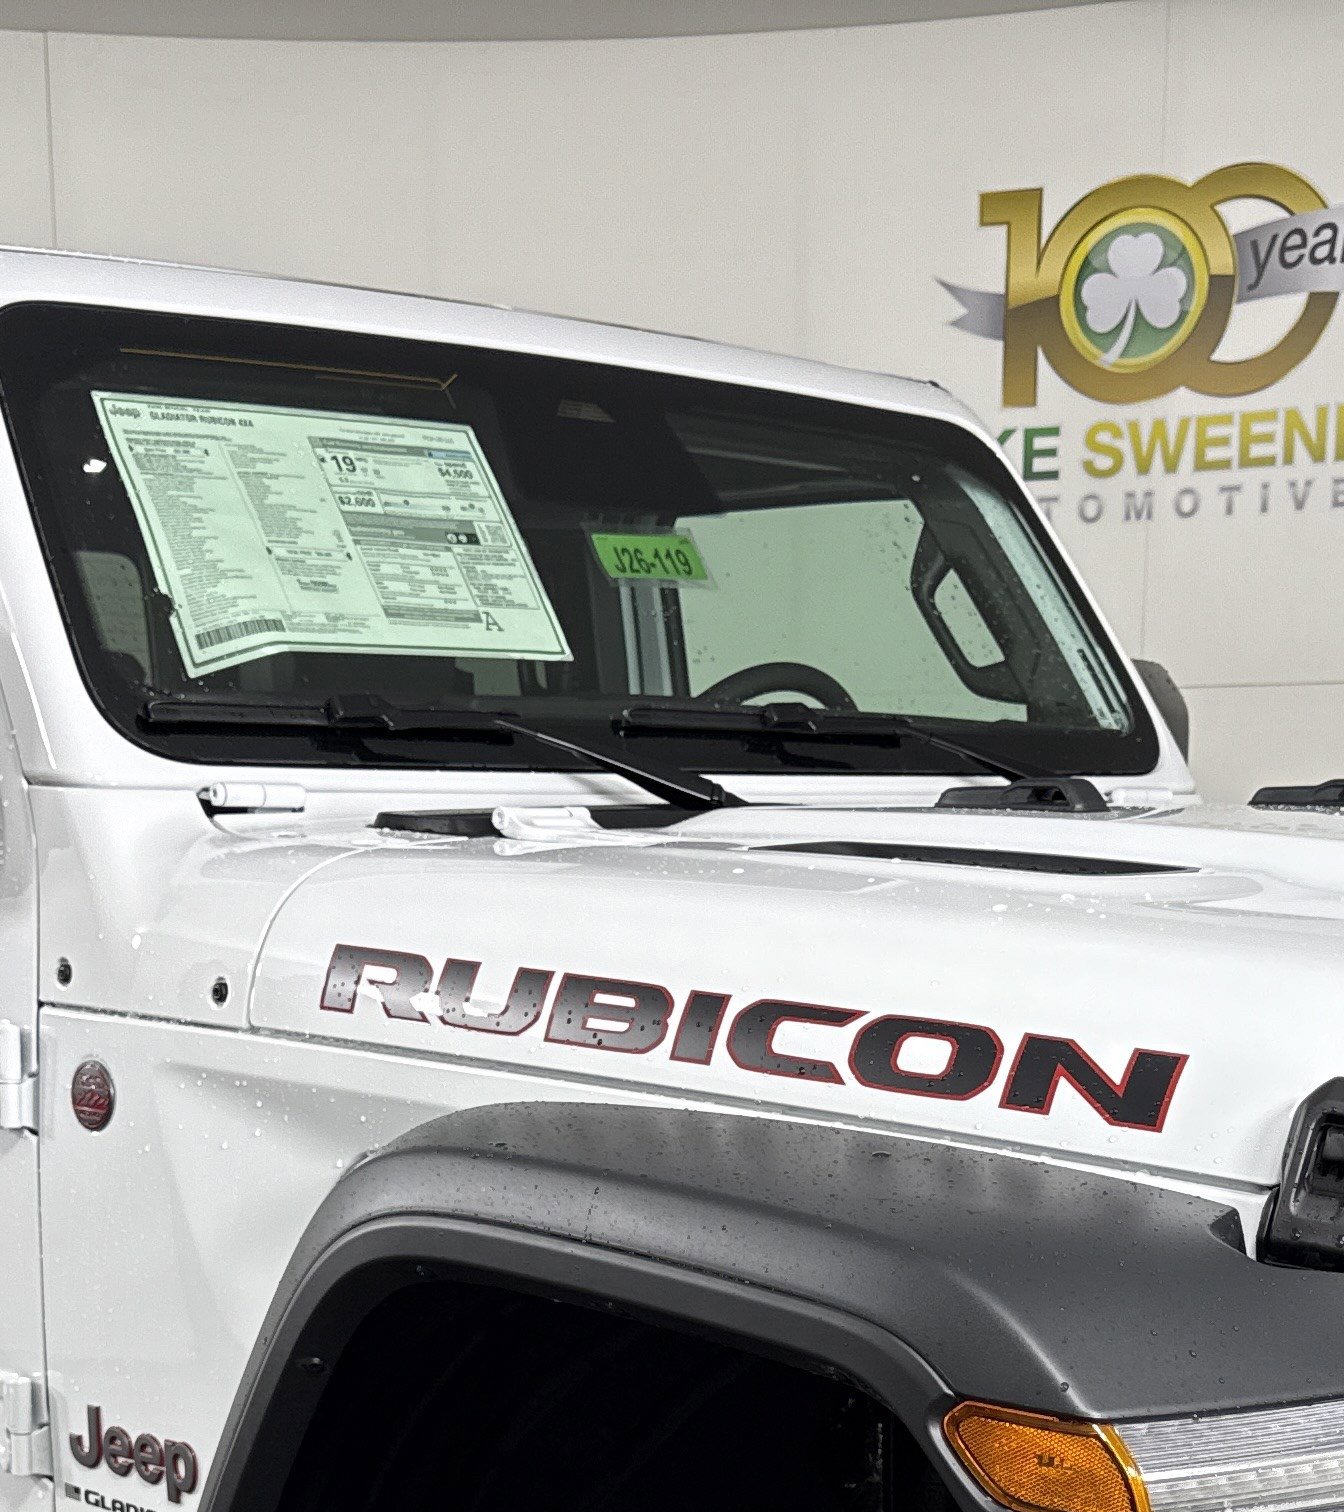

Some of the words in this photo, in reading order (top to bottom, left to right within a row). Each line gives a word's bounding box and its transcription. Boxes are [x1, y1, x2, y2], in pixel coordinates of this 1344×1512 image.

[330, 455, 357, 473] 19
[612, 546, 693, 577] J26-119
[319, 943, 1190, 1132] RUBICON
[69, 1404, 199, 1504] Jeep
